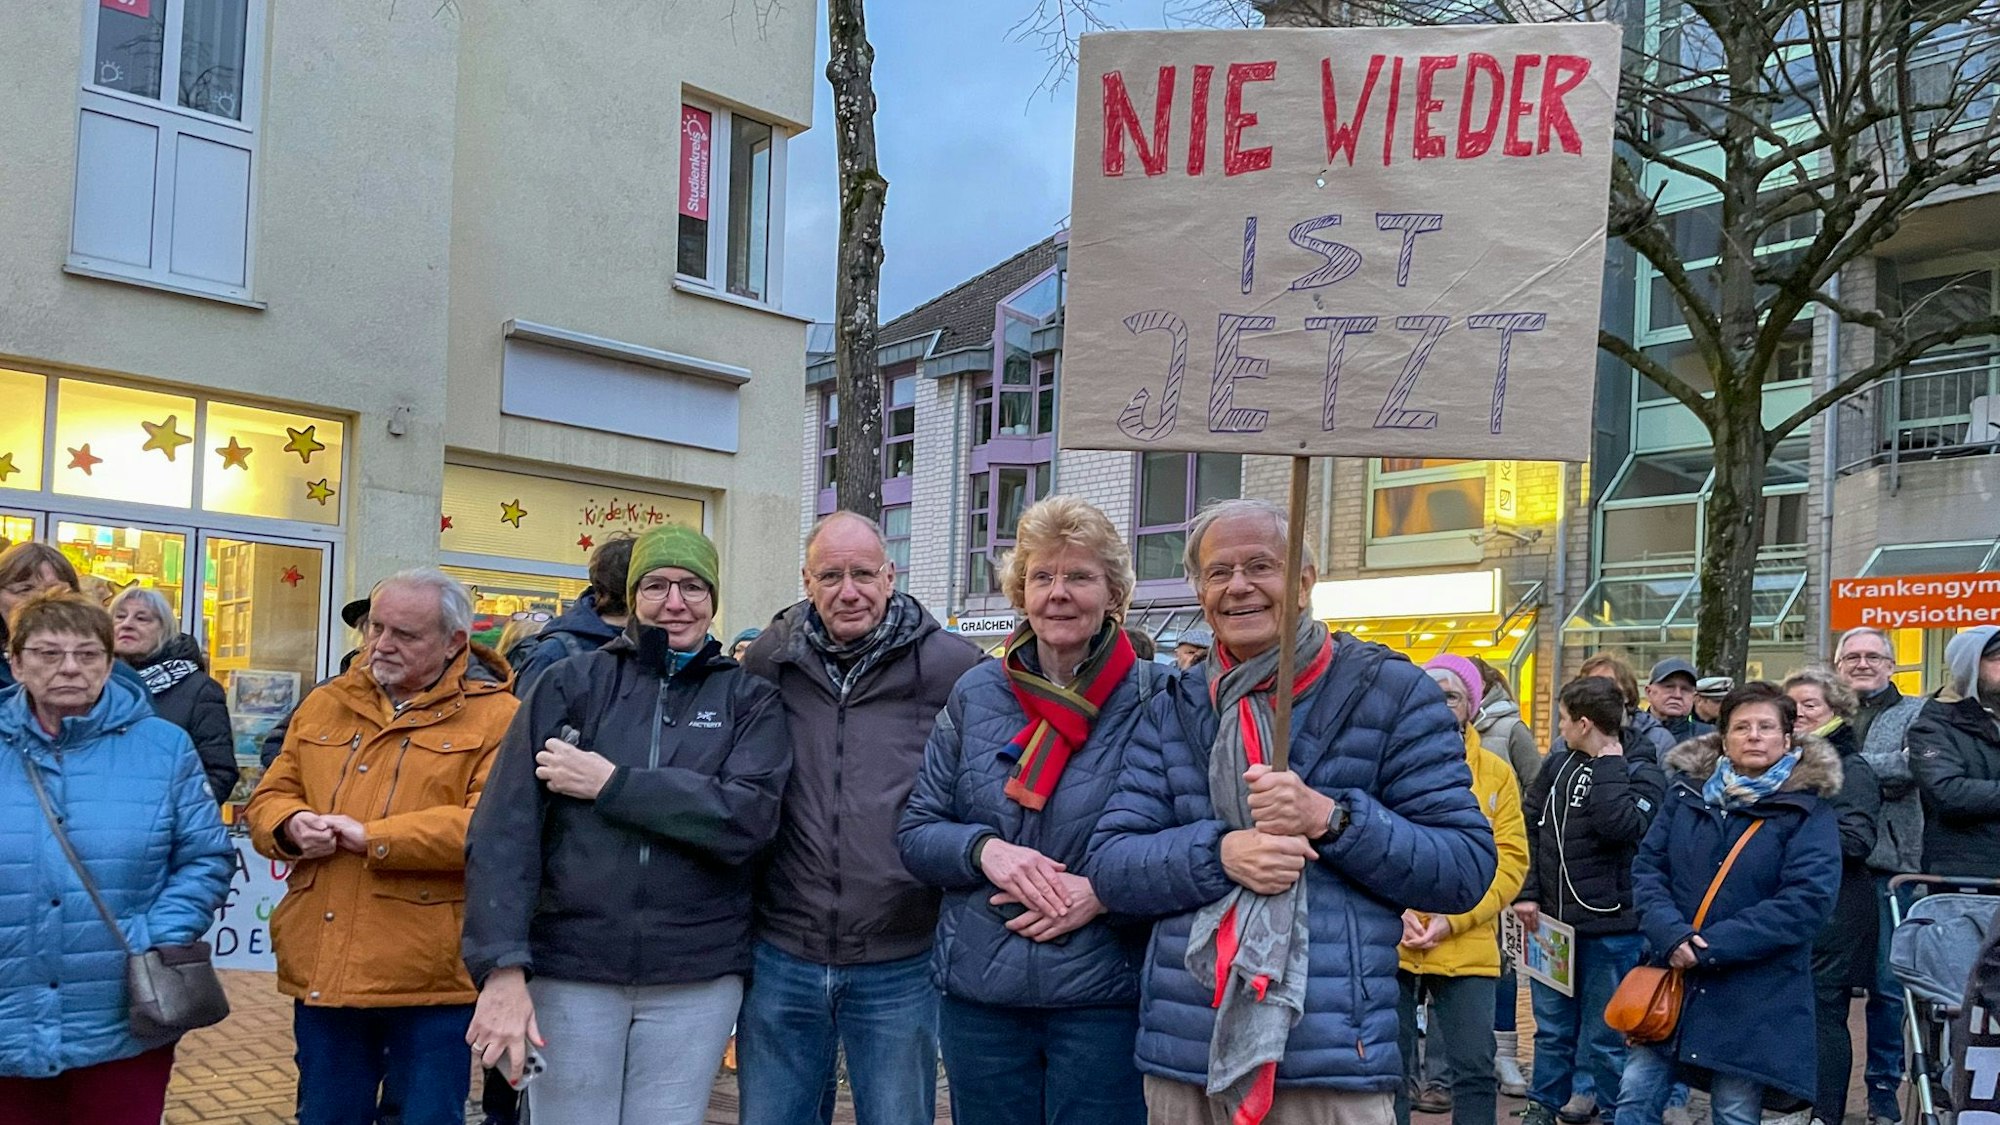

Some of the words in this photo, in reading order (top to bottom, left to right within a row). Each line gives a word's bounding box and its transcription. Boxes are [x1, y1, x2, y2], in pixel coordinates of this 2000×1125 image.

[1102, 61, 1277, 178] NIE
[1321, 52, 1591, 167] WIEDER
[687, 131, 702, 212] Studienkreis
[700, 149, 709, 200] NACHHILFE
[1240, 212, 1444, 295] IST
[1116, 308, 1547, 442] JETZT
[1838, 578, 2000, 599] Krankengym
[1861, 604, 2000, 628] Physiother
[961, 619, 1013, 632] GRAICHEN
